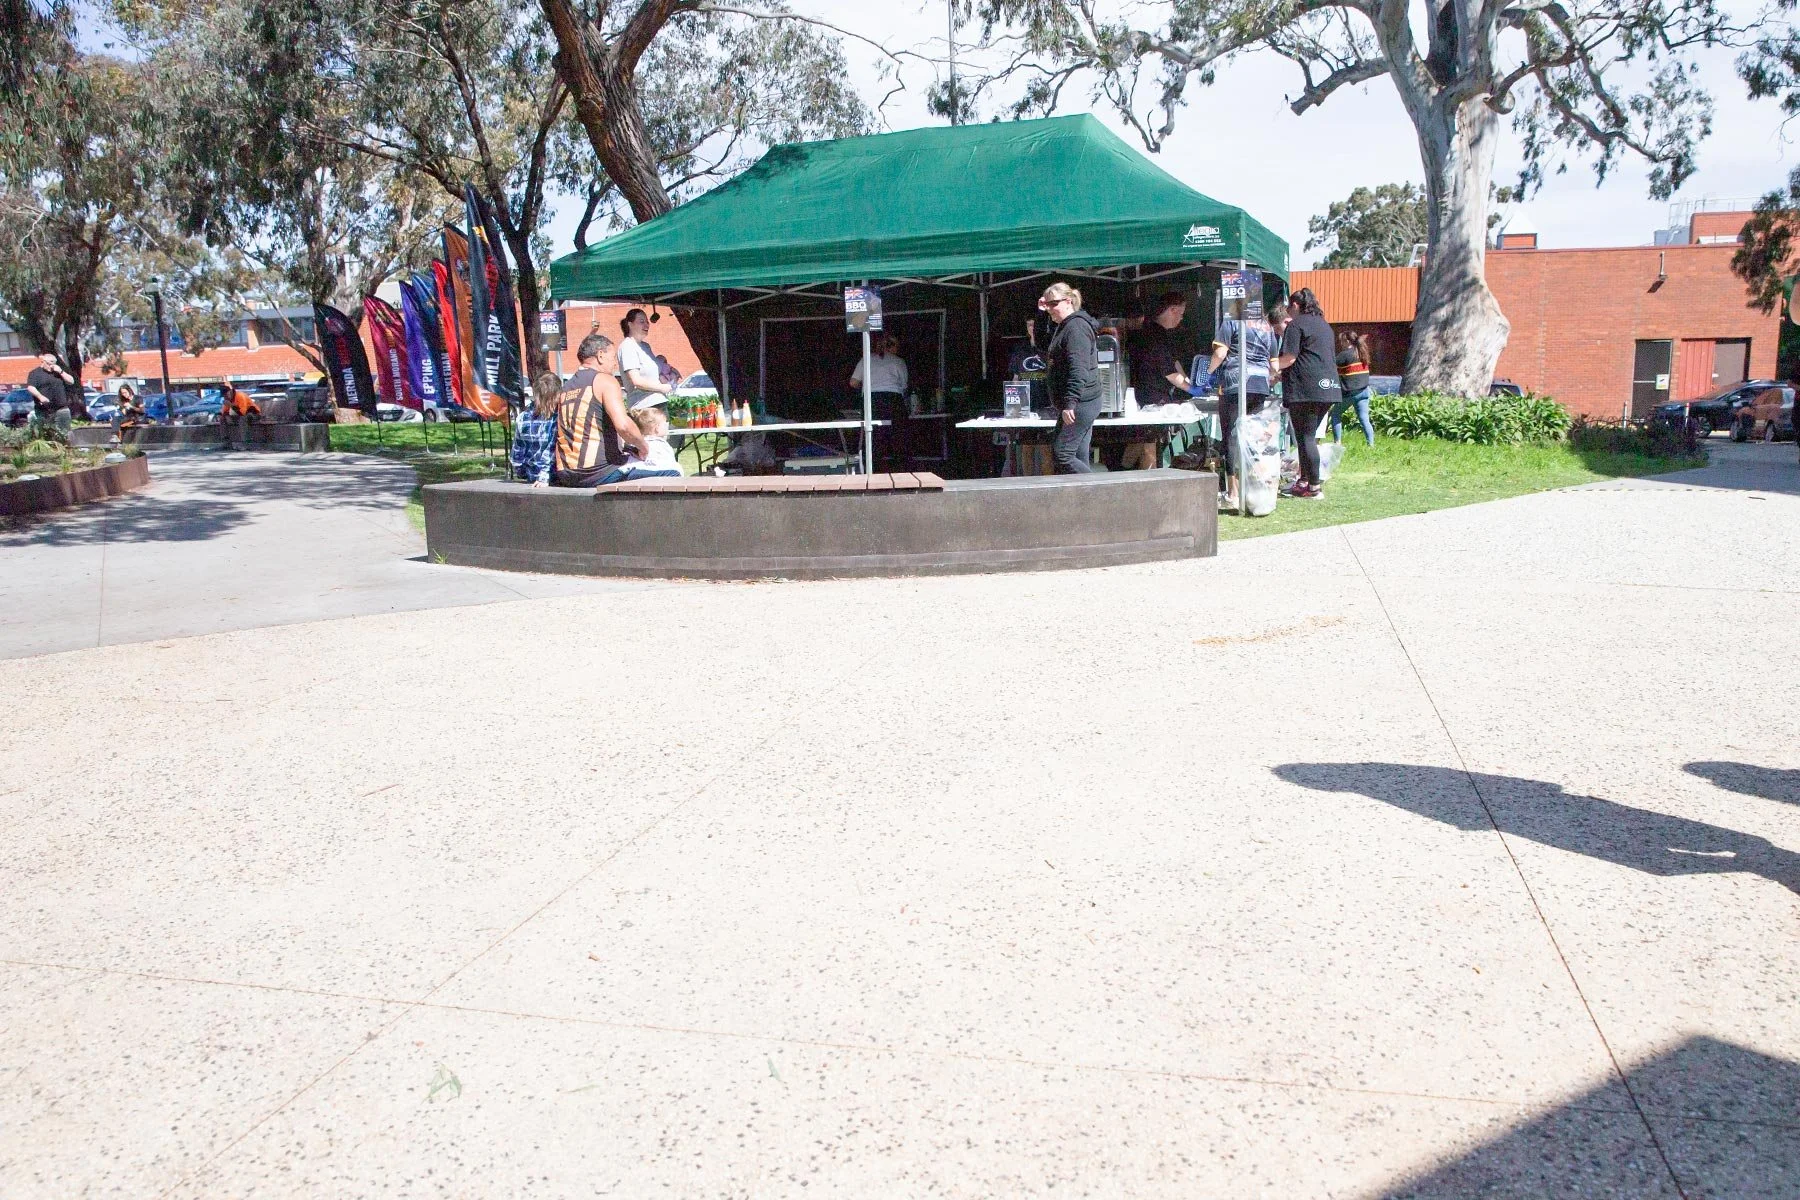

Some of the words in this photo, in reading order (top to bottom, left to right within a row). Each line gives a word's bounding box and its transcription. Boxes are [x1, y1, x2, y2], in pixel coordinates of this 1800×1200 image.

[1222, 287, 1246, 296] BBQ
[541, 323, 560, 331] BBQ
[389, 348, 401, 378] MORANG
[422, 359, 435, 395] EPPING
[485, 356, 500, 386] MILL
[342, 367, 358, 405] MERNDA
[394, 378, 404, 401] SOUTH
